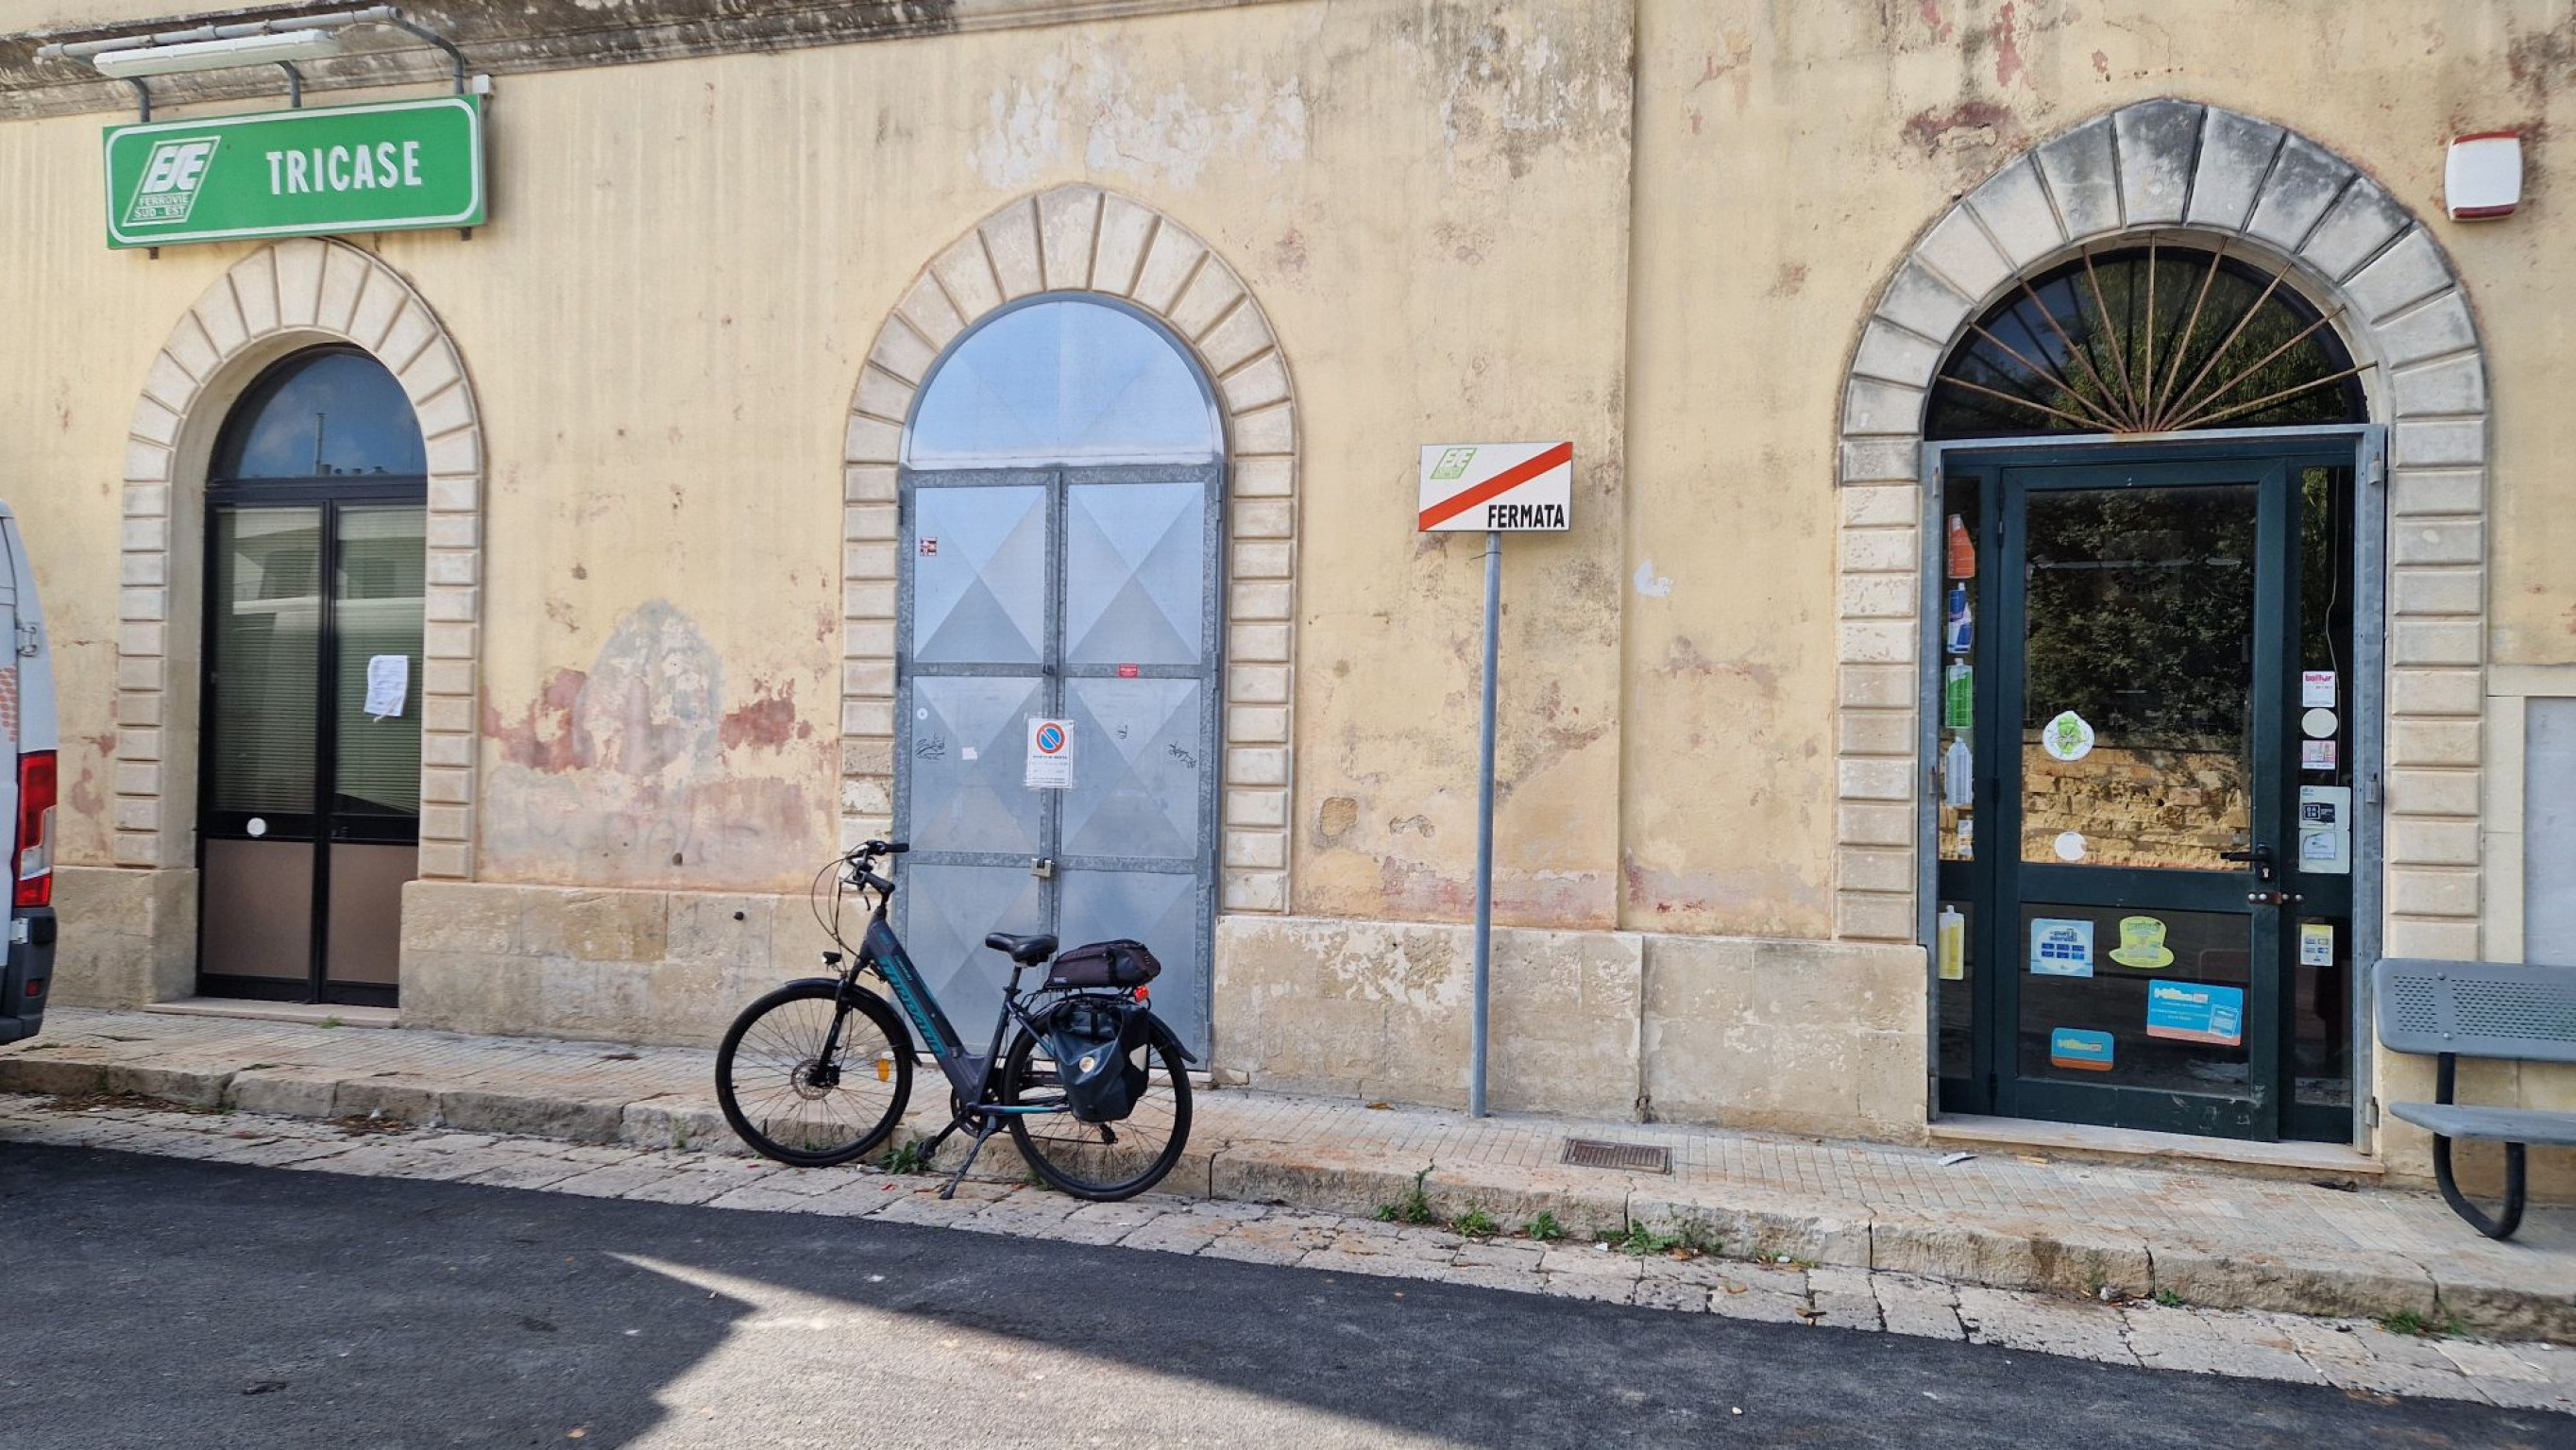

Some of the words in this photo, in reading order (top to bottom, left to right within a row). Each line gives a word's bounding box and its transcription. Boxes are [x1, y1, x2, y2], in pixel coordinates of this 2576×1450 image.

[266, 141, 422, 195] TRICASE
[139, 194, 189, 207] FERROVIE
[1487, 504, 1566, 528] FERMATA
